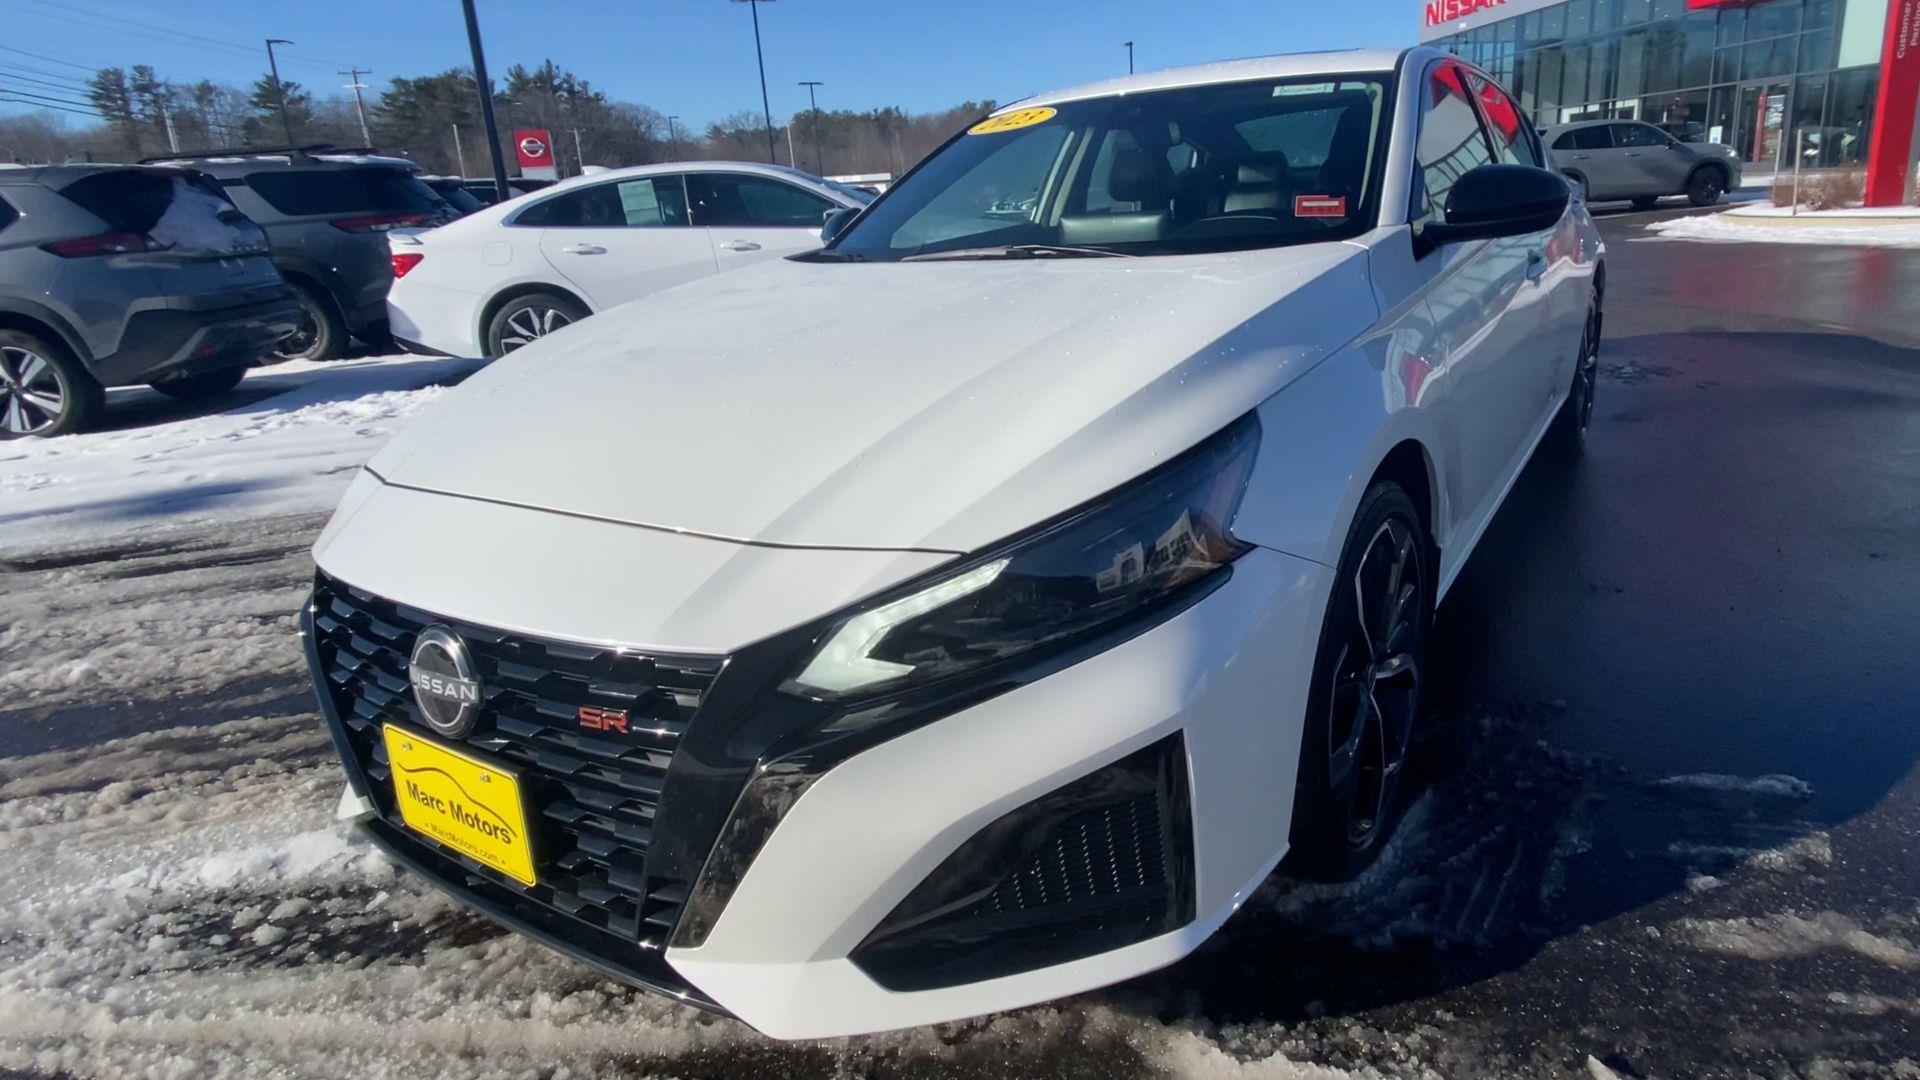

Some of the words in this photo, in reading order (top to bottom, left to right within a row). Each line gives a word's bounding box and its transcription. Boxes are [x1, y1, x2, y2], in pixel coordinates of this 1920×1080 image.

[1426, 0, 1506, 26] NISSA
[1897, 1, 1911, 59] Customer
[410, 668, 476, 700] ISSAN
[579, 706, 629, 733] SR
[406, 779, 446, 815] Marc
[449, 800, 512, 845] Motors
